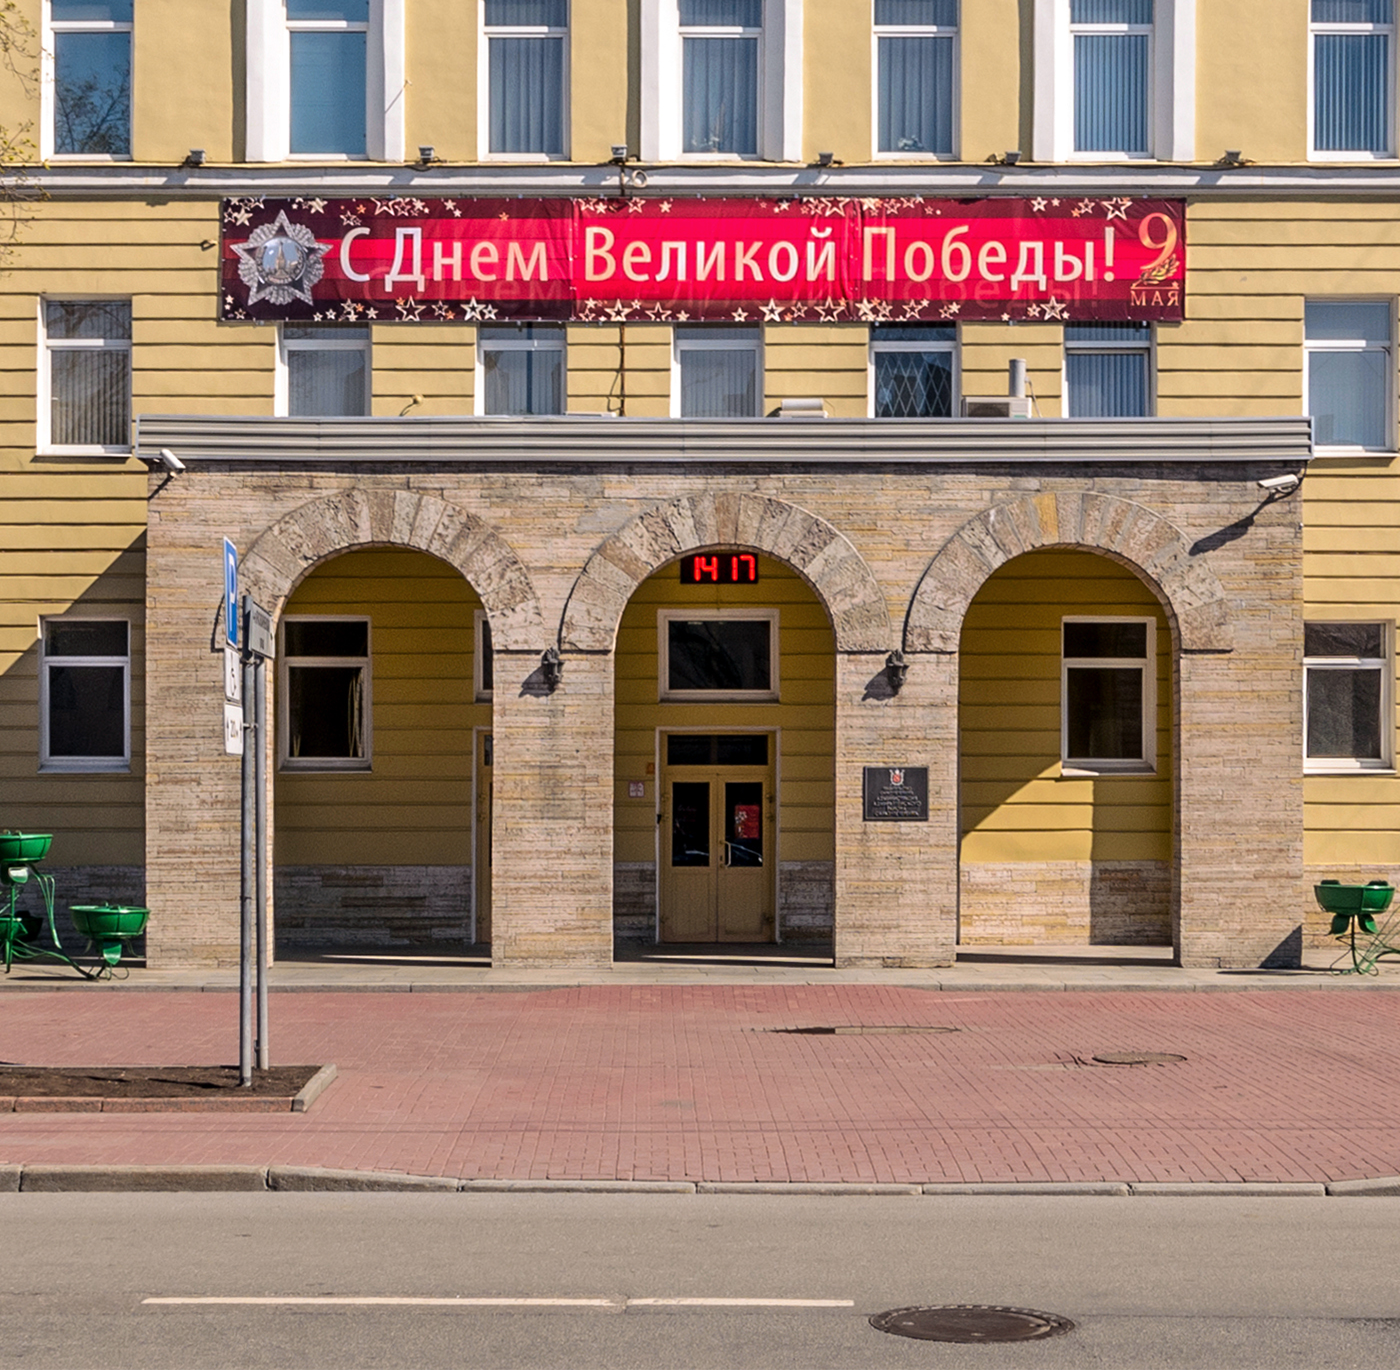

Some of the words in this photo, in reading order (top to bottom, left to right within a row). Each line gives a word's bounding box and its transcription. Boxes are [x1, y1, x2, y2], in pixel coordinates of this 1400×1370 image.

[340, 227, 371, 282] С
[384, 226, 549, 293] Днем
[584, 225, 836, 282] Великой
[862, 224, 1115, 292] Победы!
[1138, 212, 1178, 270] 9
[1130, 290, 1180, 307] МАЯ
